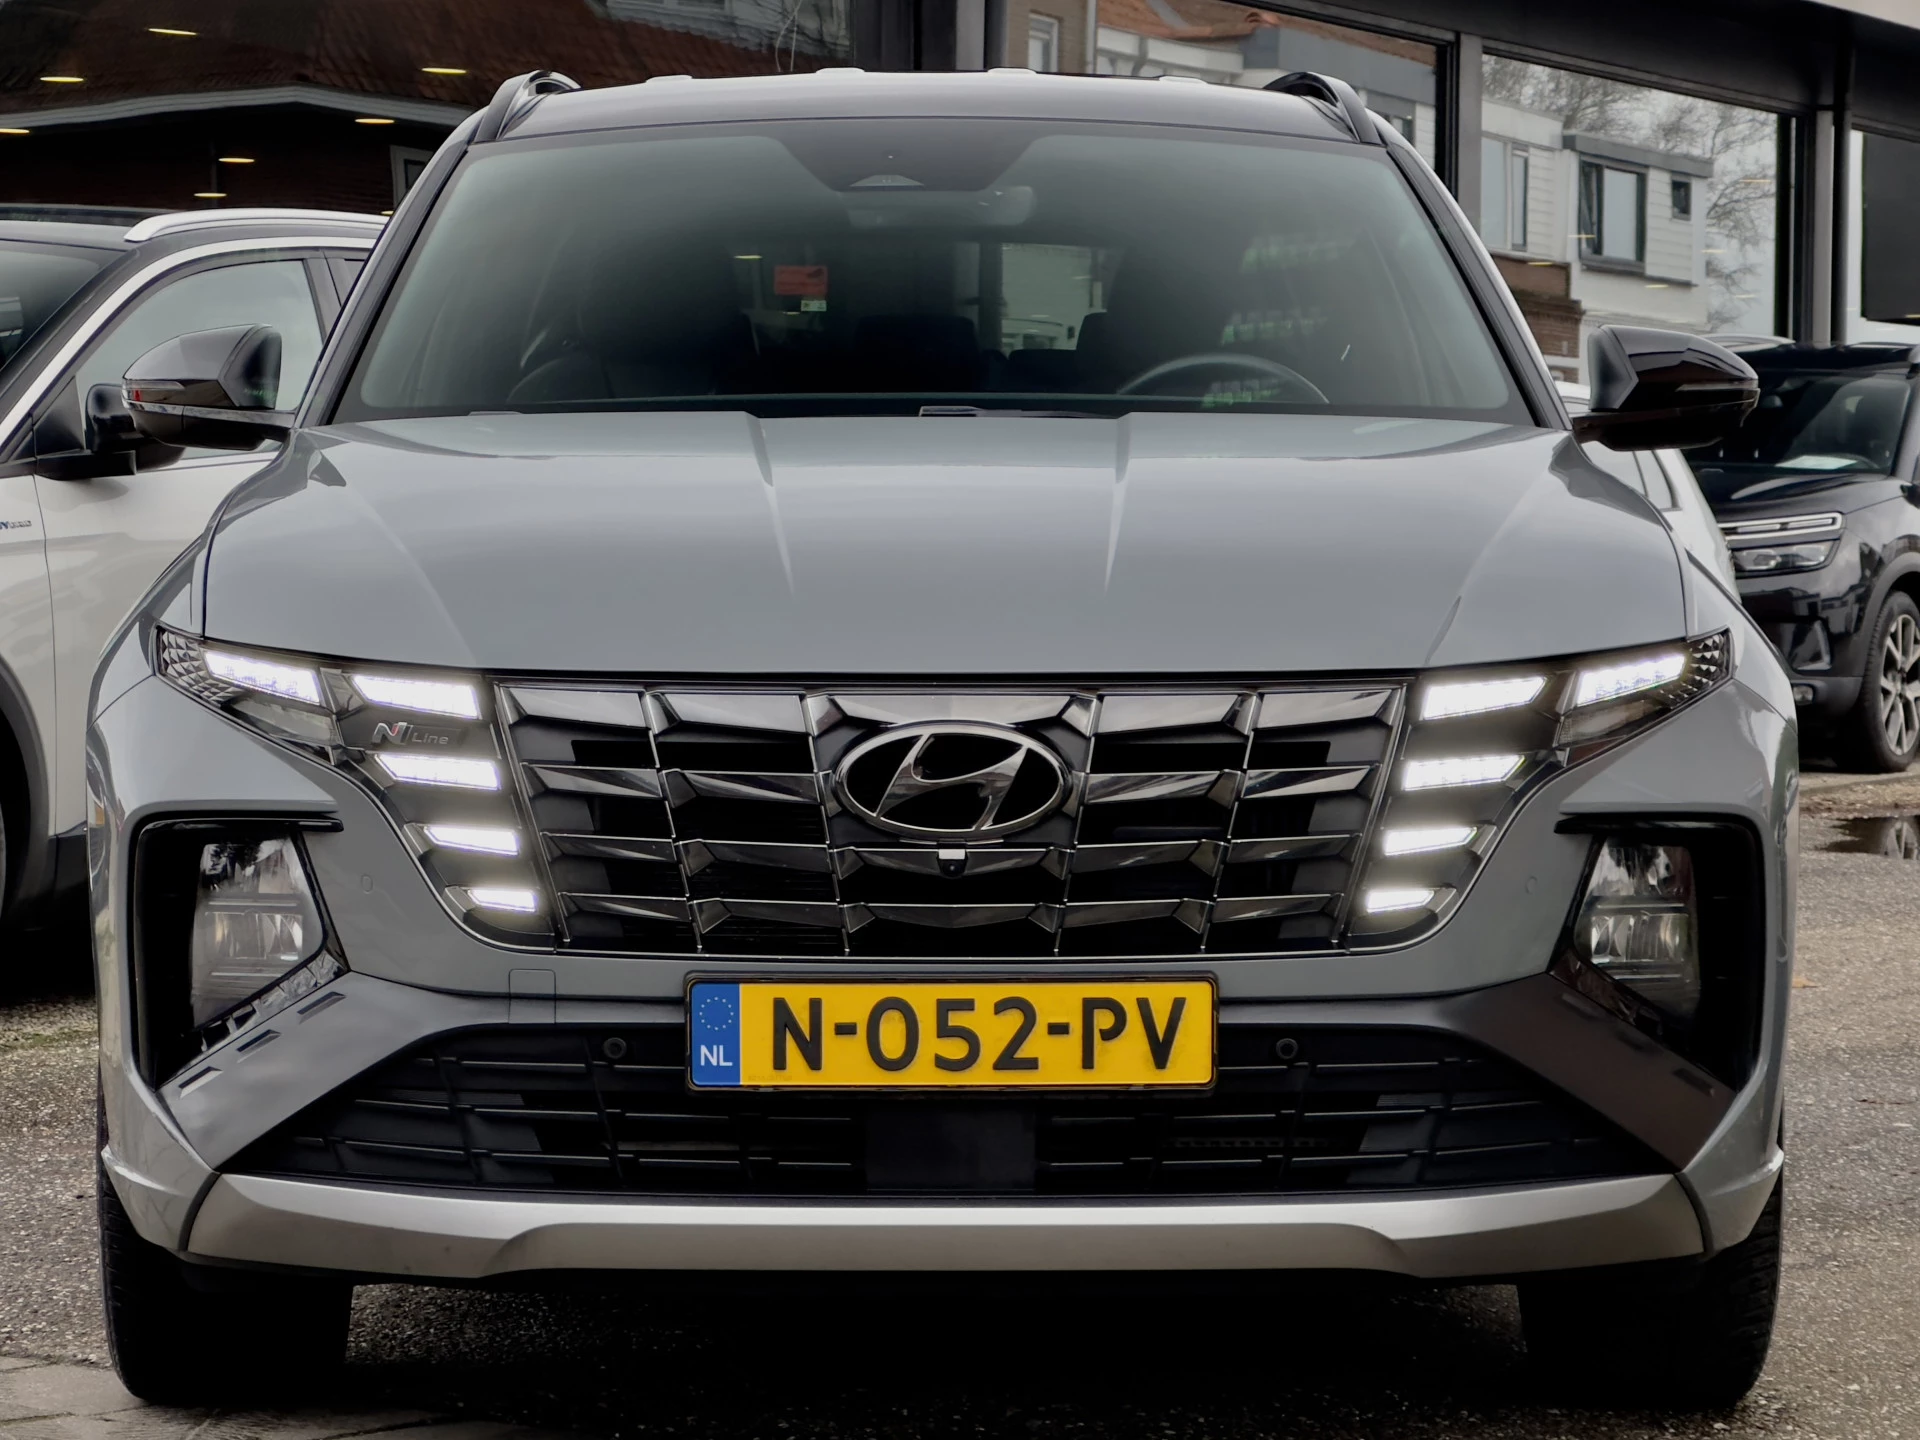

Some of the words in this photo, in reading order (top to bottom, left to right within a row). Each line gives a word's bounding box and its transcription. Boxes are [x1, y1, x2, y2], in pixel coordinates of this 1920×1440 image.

[411, 732, 449, 745] Line
[773, 996, 1187, 1071] N-052-PV
[700, 1044, 733, 1067] NL
